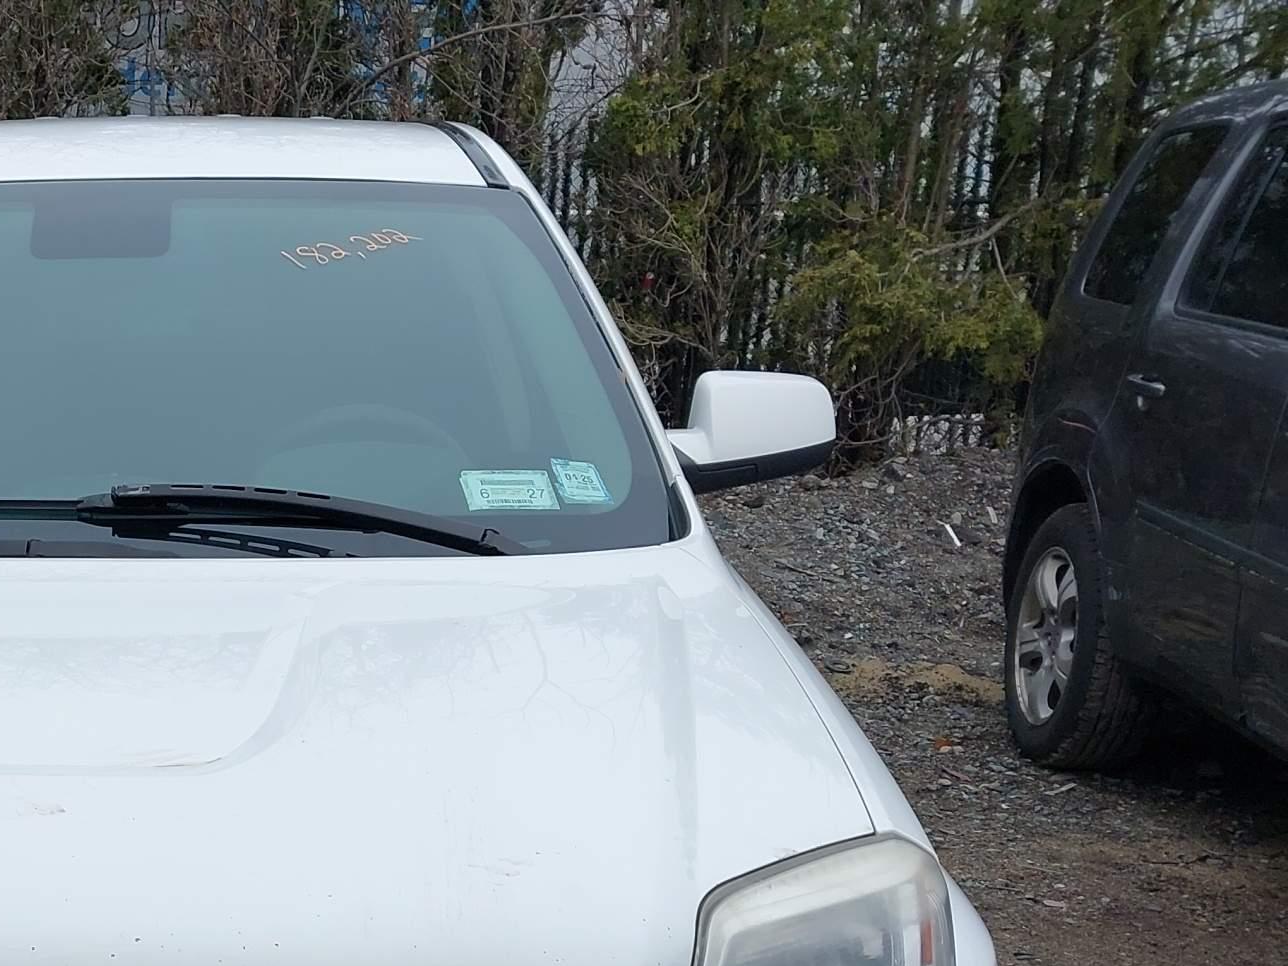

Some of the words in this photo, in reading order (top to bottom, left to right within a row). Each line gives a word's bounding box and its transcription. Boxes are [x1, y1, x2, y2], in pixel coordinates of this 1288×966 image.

[280, 228, 424, 269] 182,202
[479, 488, 490, 499] 6
[526, 488, 545, 499] 27
